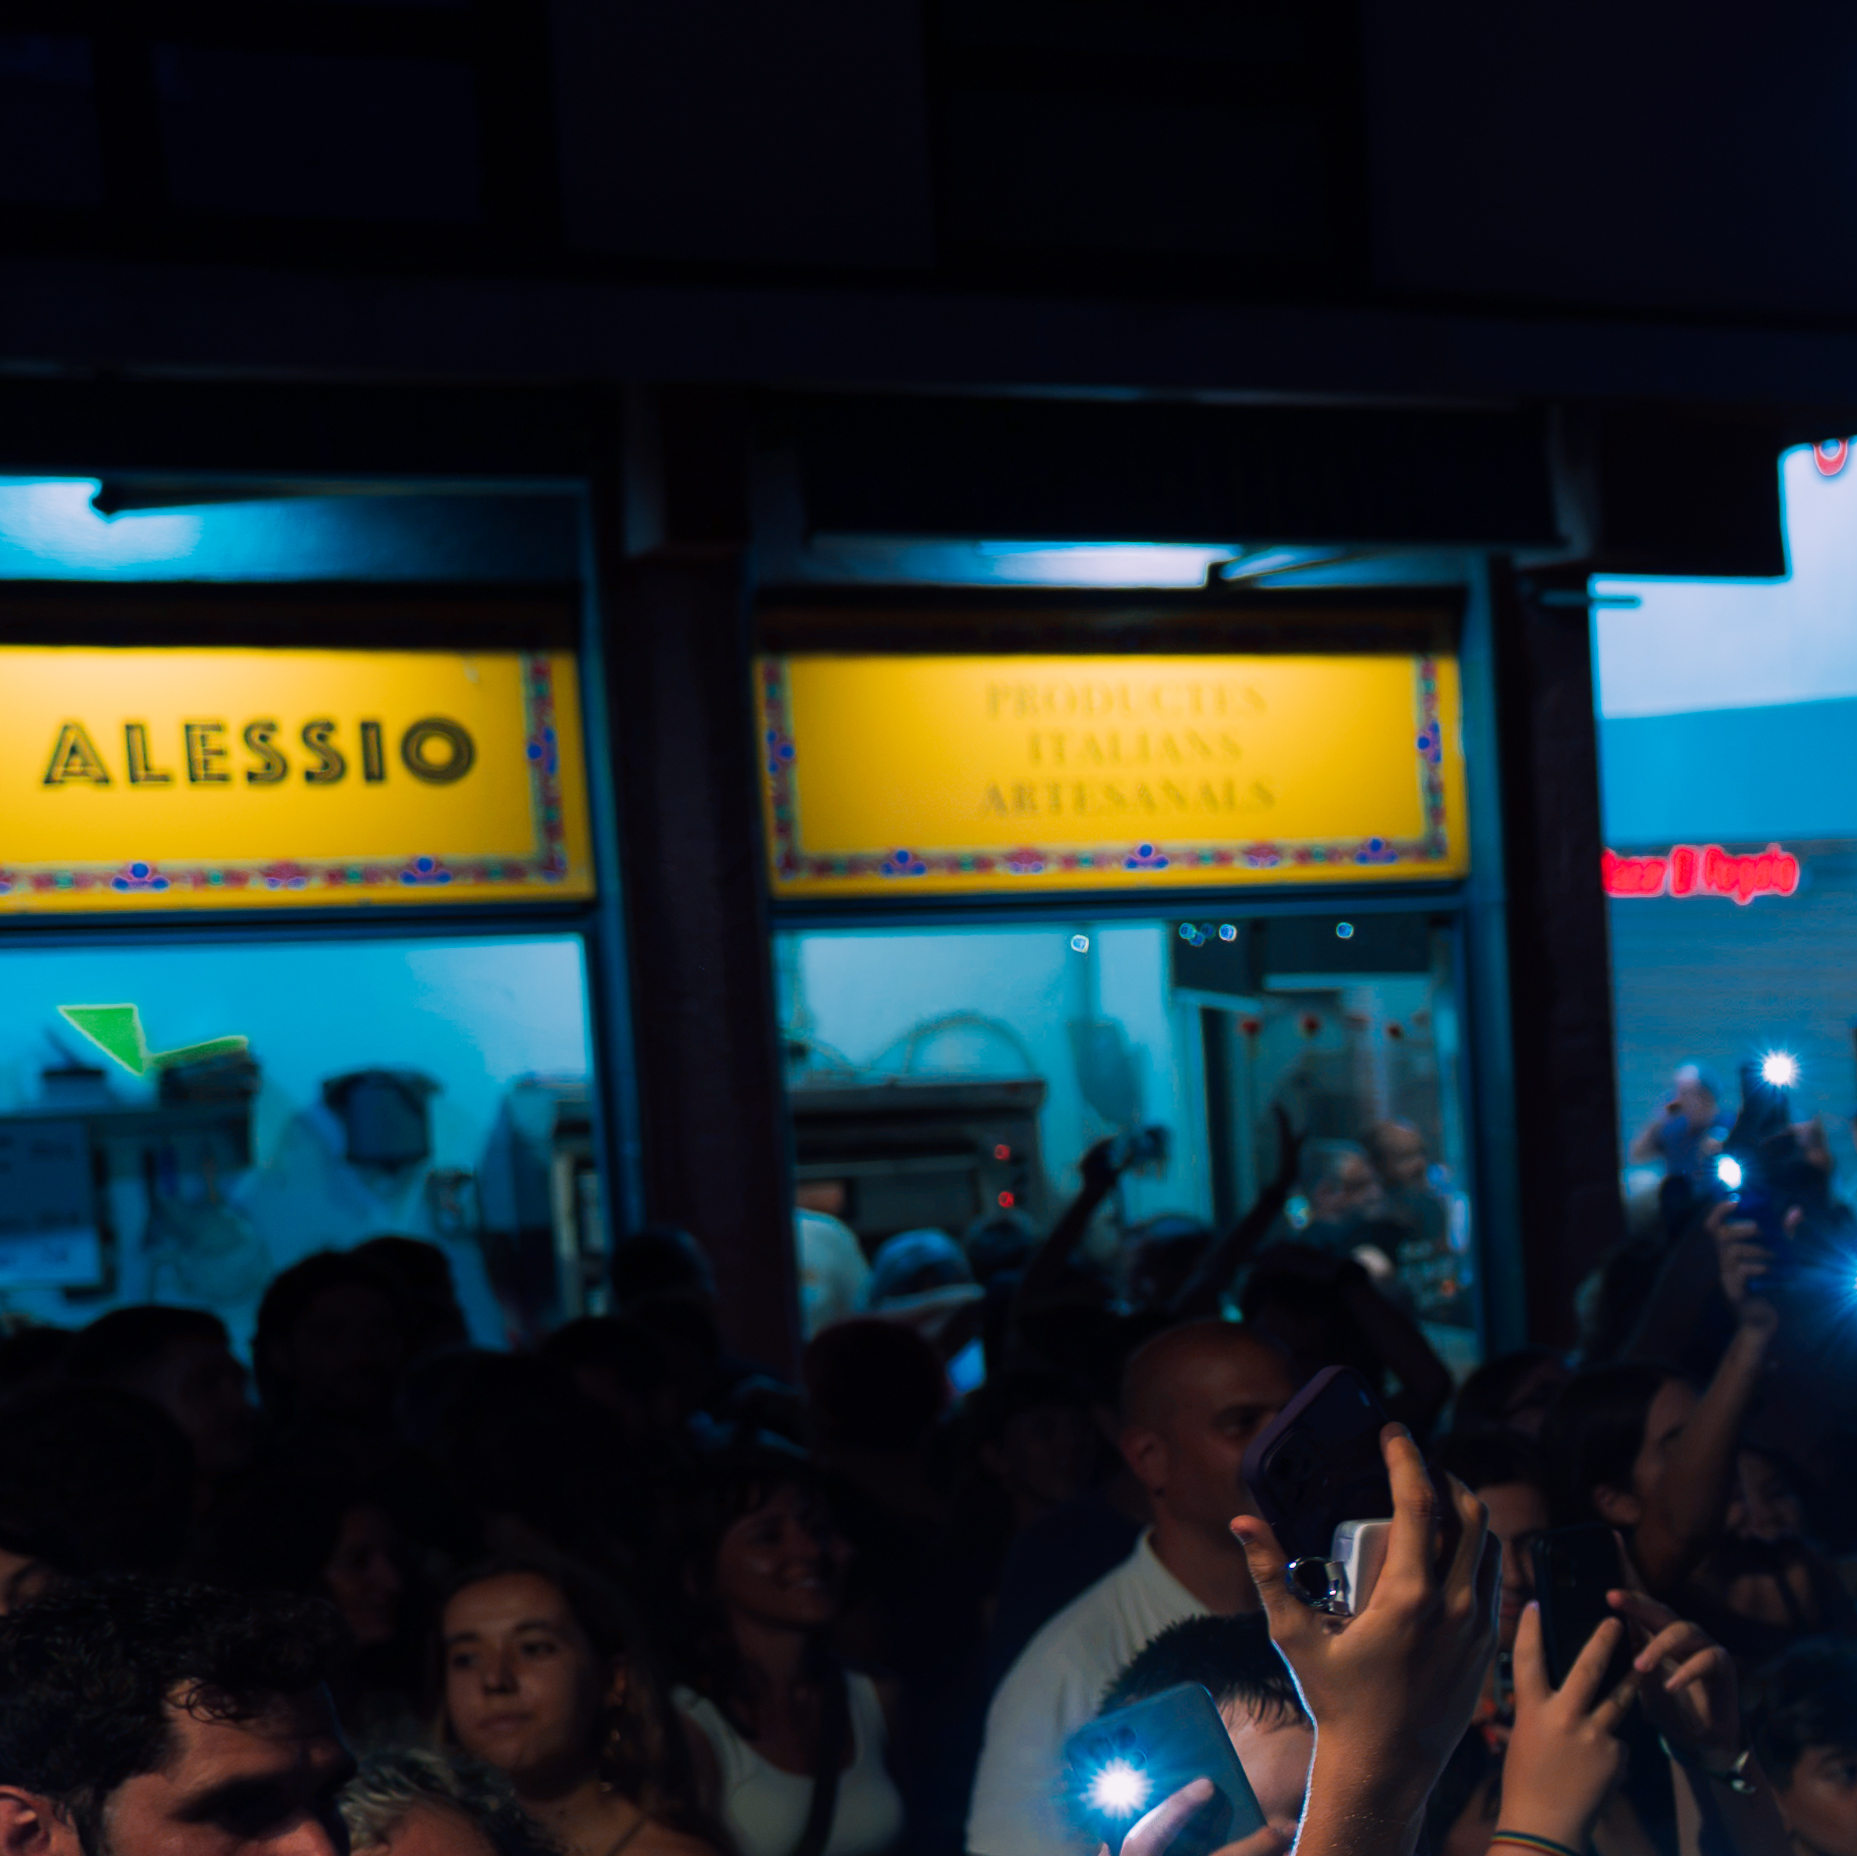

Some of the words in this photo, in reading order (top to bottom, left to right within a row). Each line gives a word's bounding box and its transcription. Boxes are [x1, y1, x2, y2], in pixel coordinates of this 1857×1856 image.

[983, 678, 1269, 720] PRODUCTES
[43, 715, 476, 787] ALESSIO
[1026, 726, 1244, 768] ITALIANS
[981, 778, 1278, 817] ARTESANALS
